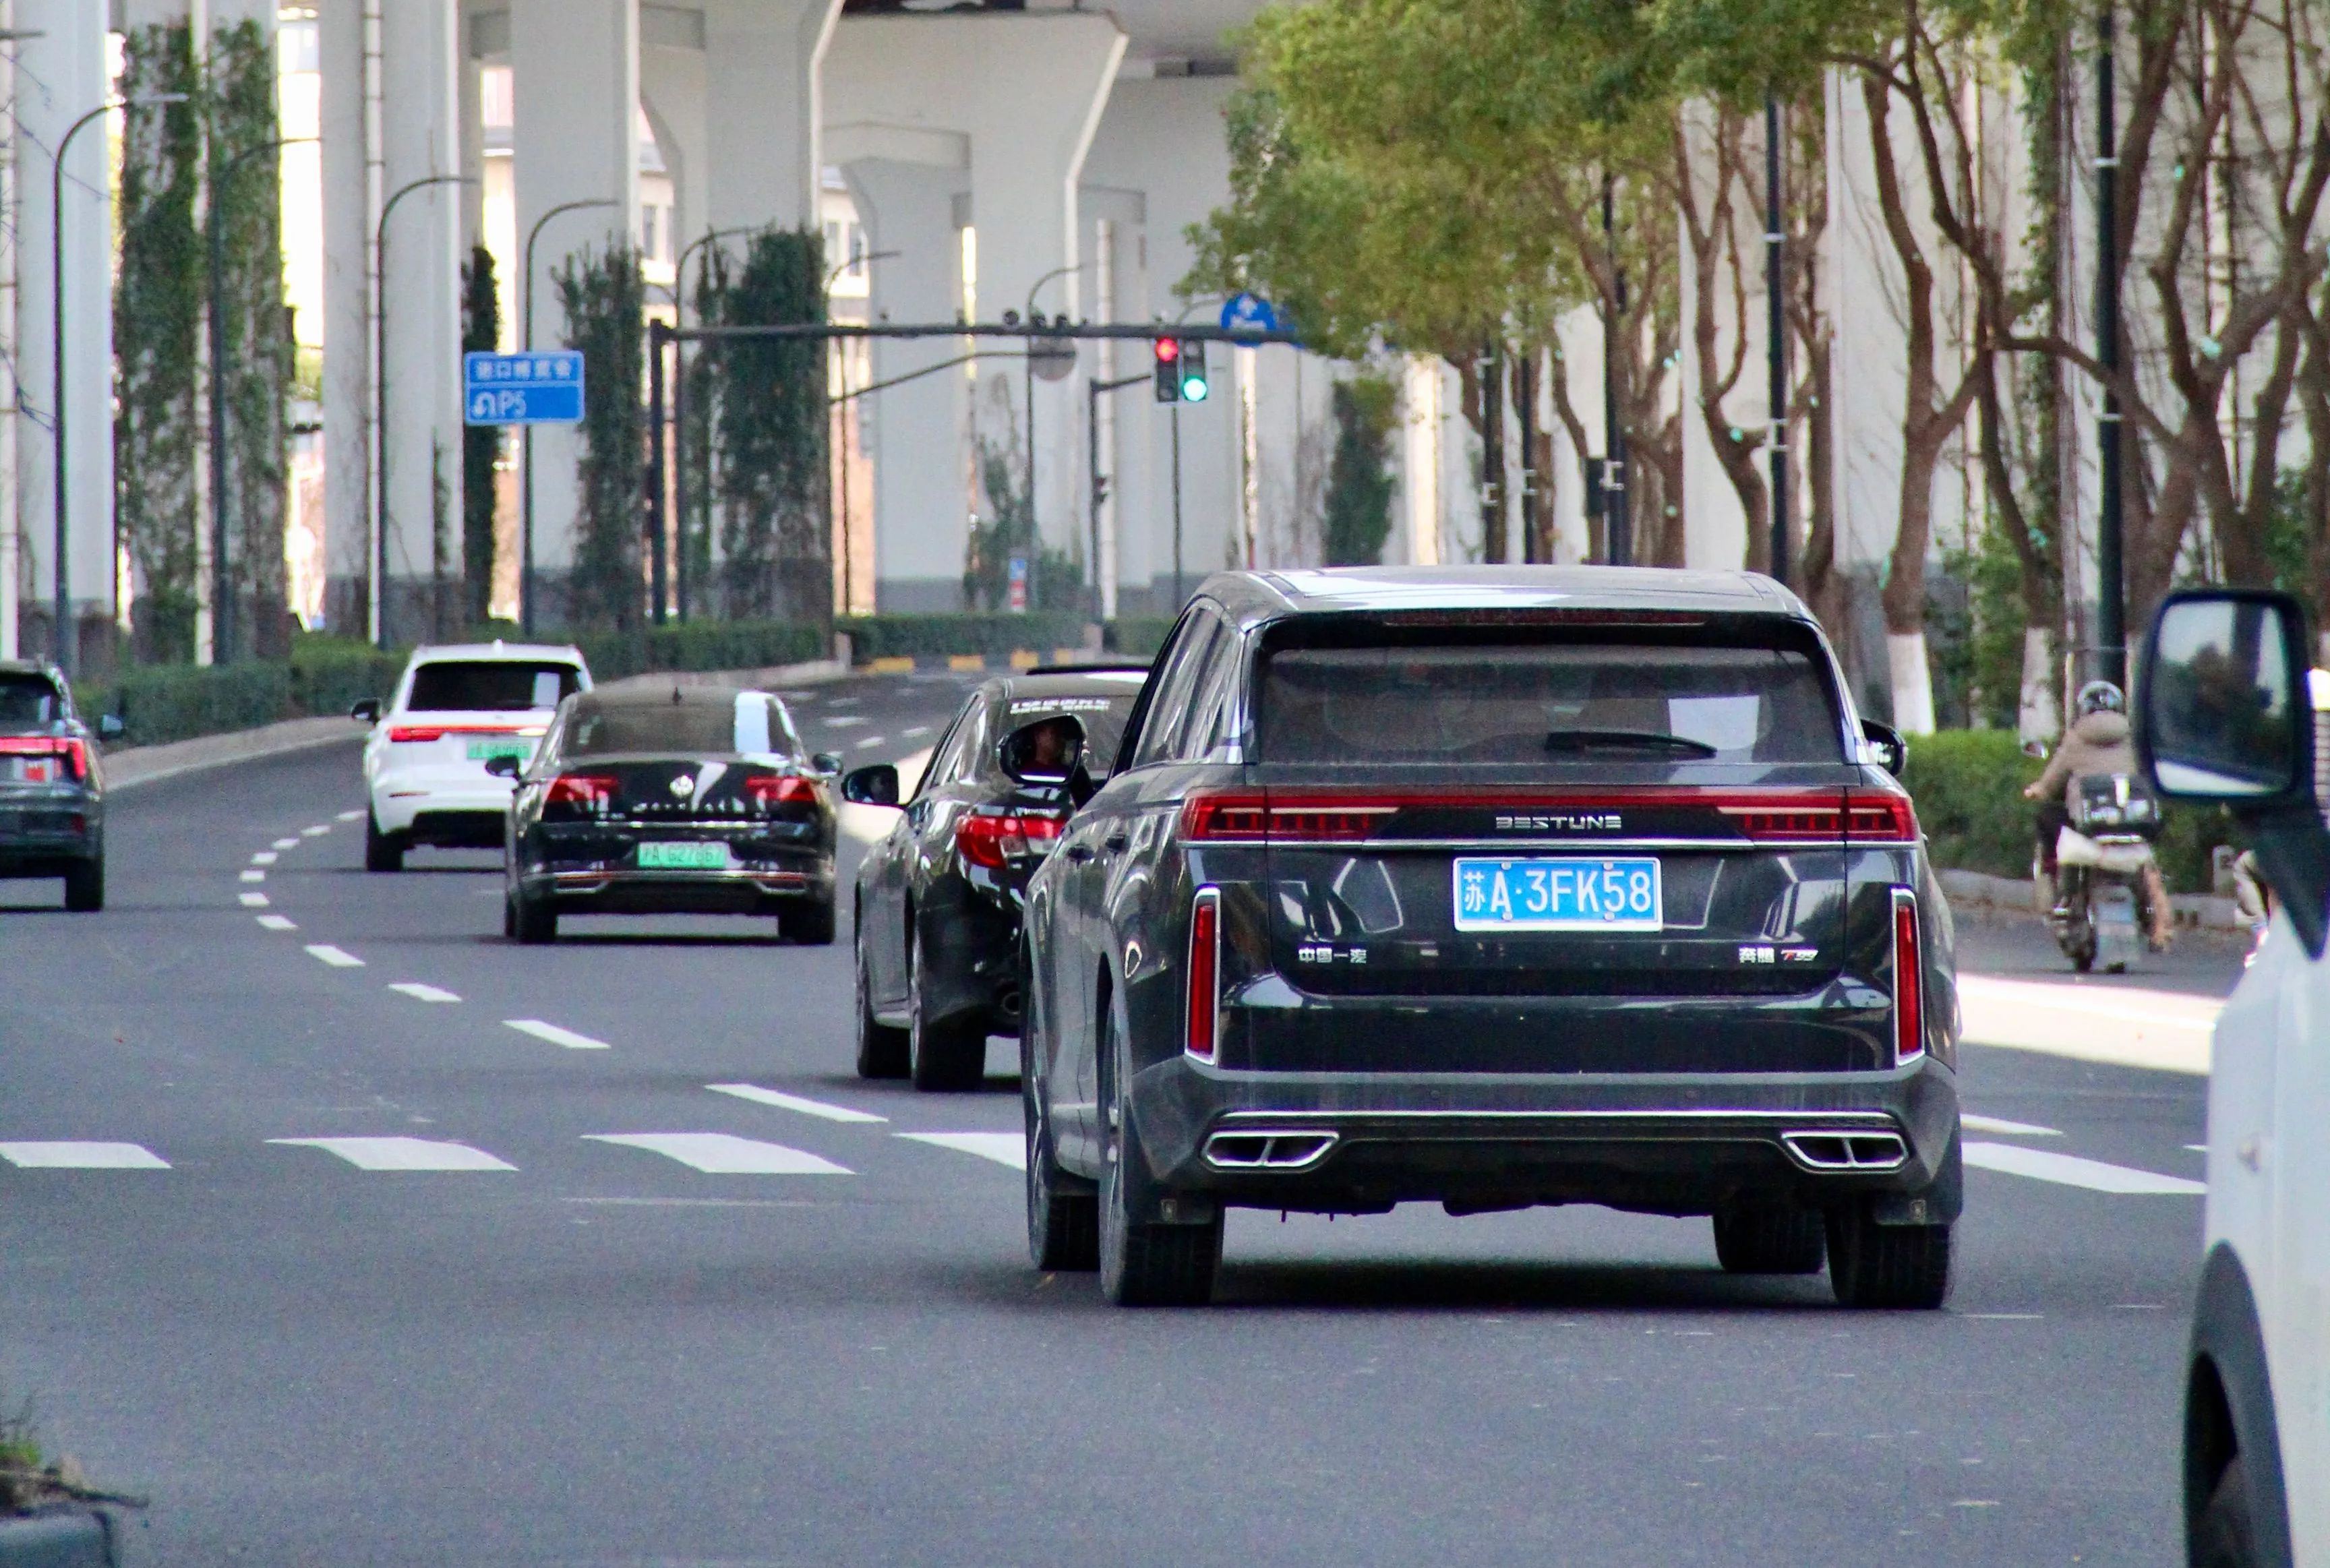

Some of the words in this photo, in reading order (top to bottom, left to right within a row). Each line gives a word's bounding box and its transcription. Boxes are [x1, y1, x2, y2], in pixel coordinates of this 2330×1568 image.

[1495, 816, 1622, 830] BESTUNE
[1298, 948, 1367, 964] 中国一汽
